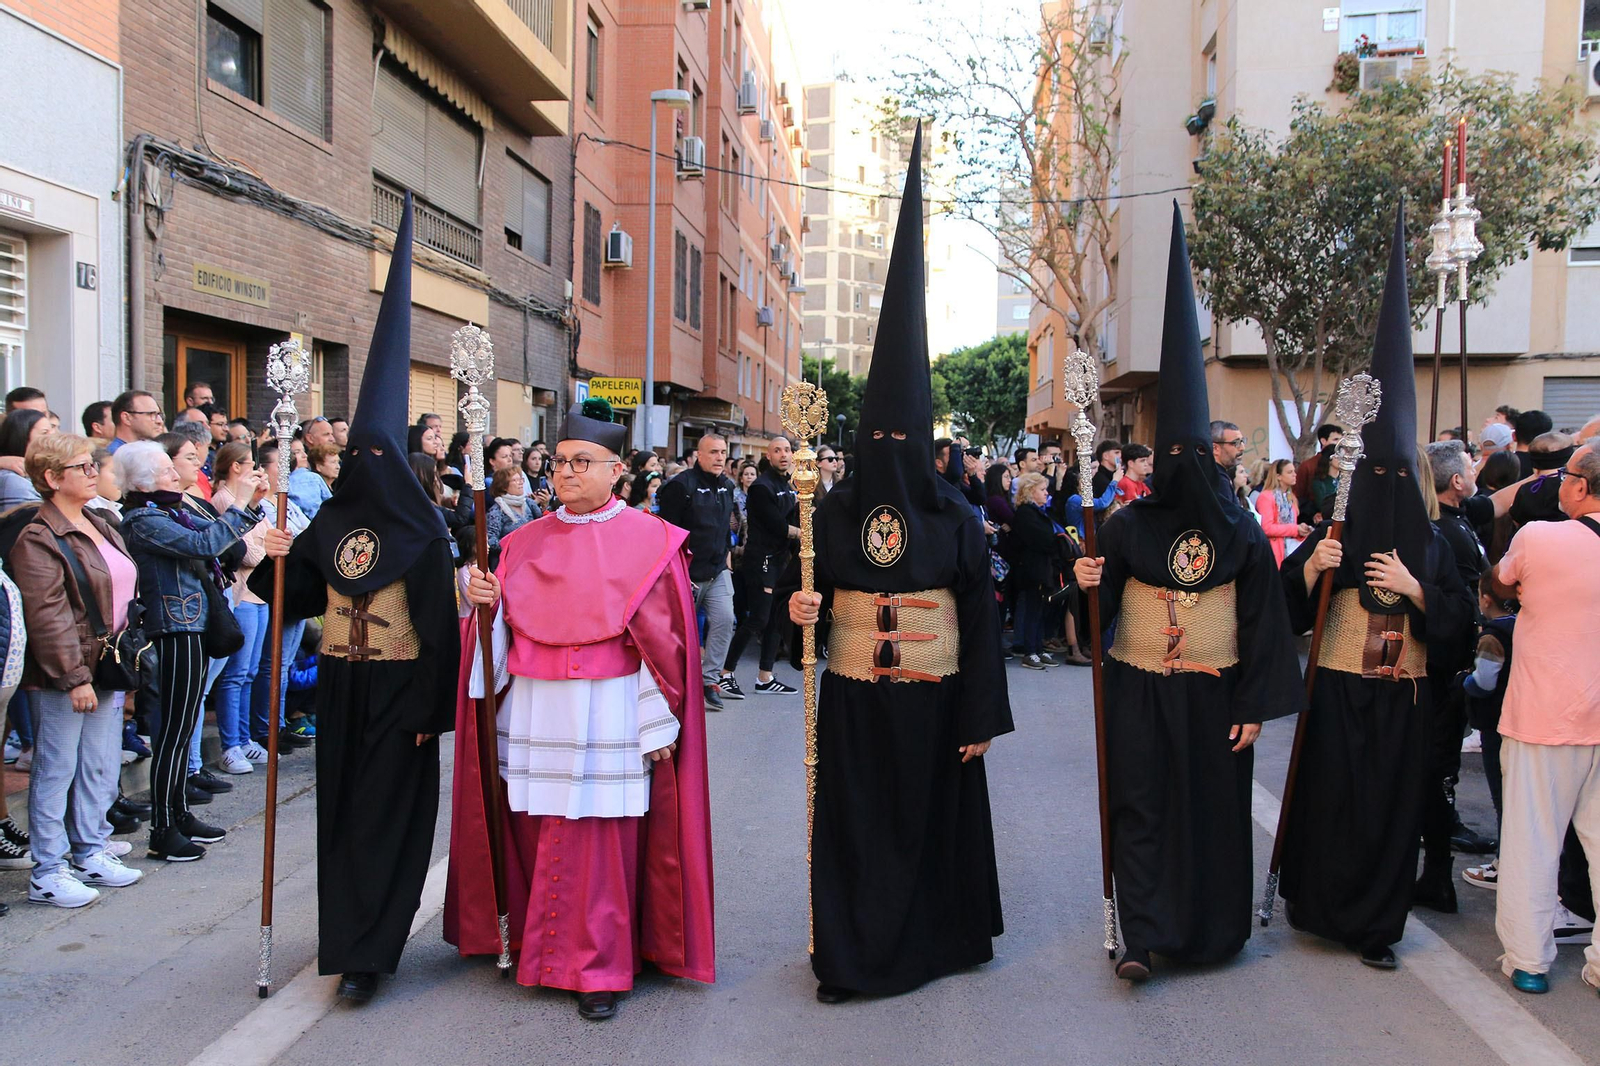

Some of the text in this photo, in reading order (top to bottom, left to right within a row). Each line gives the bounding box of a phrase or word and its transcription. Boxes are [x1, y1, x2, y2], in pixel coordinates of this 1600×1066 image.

[78, 263, 97, 288] 16
[197, 269, 266, 301] EDIFICIO WINSTON
[591, 380, 639, 390] PAPELERIA
[592, 395, 638, 405] ANCA
